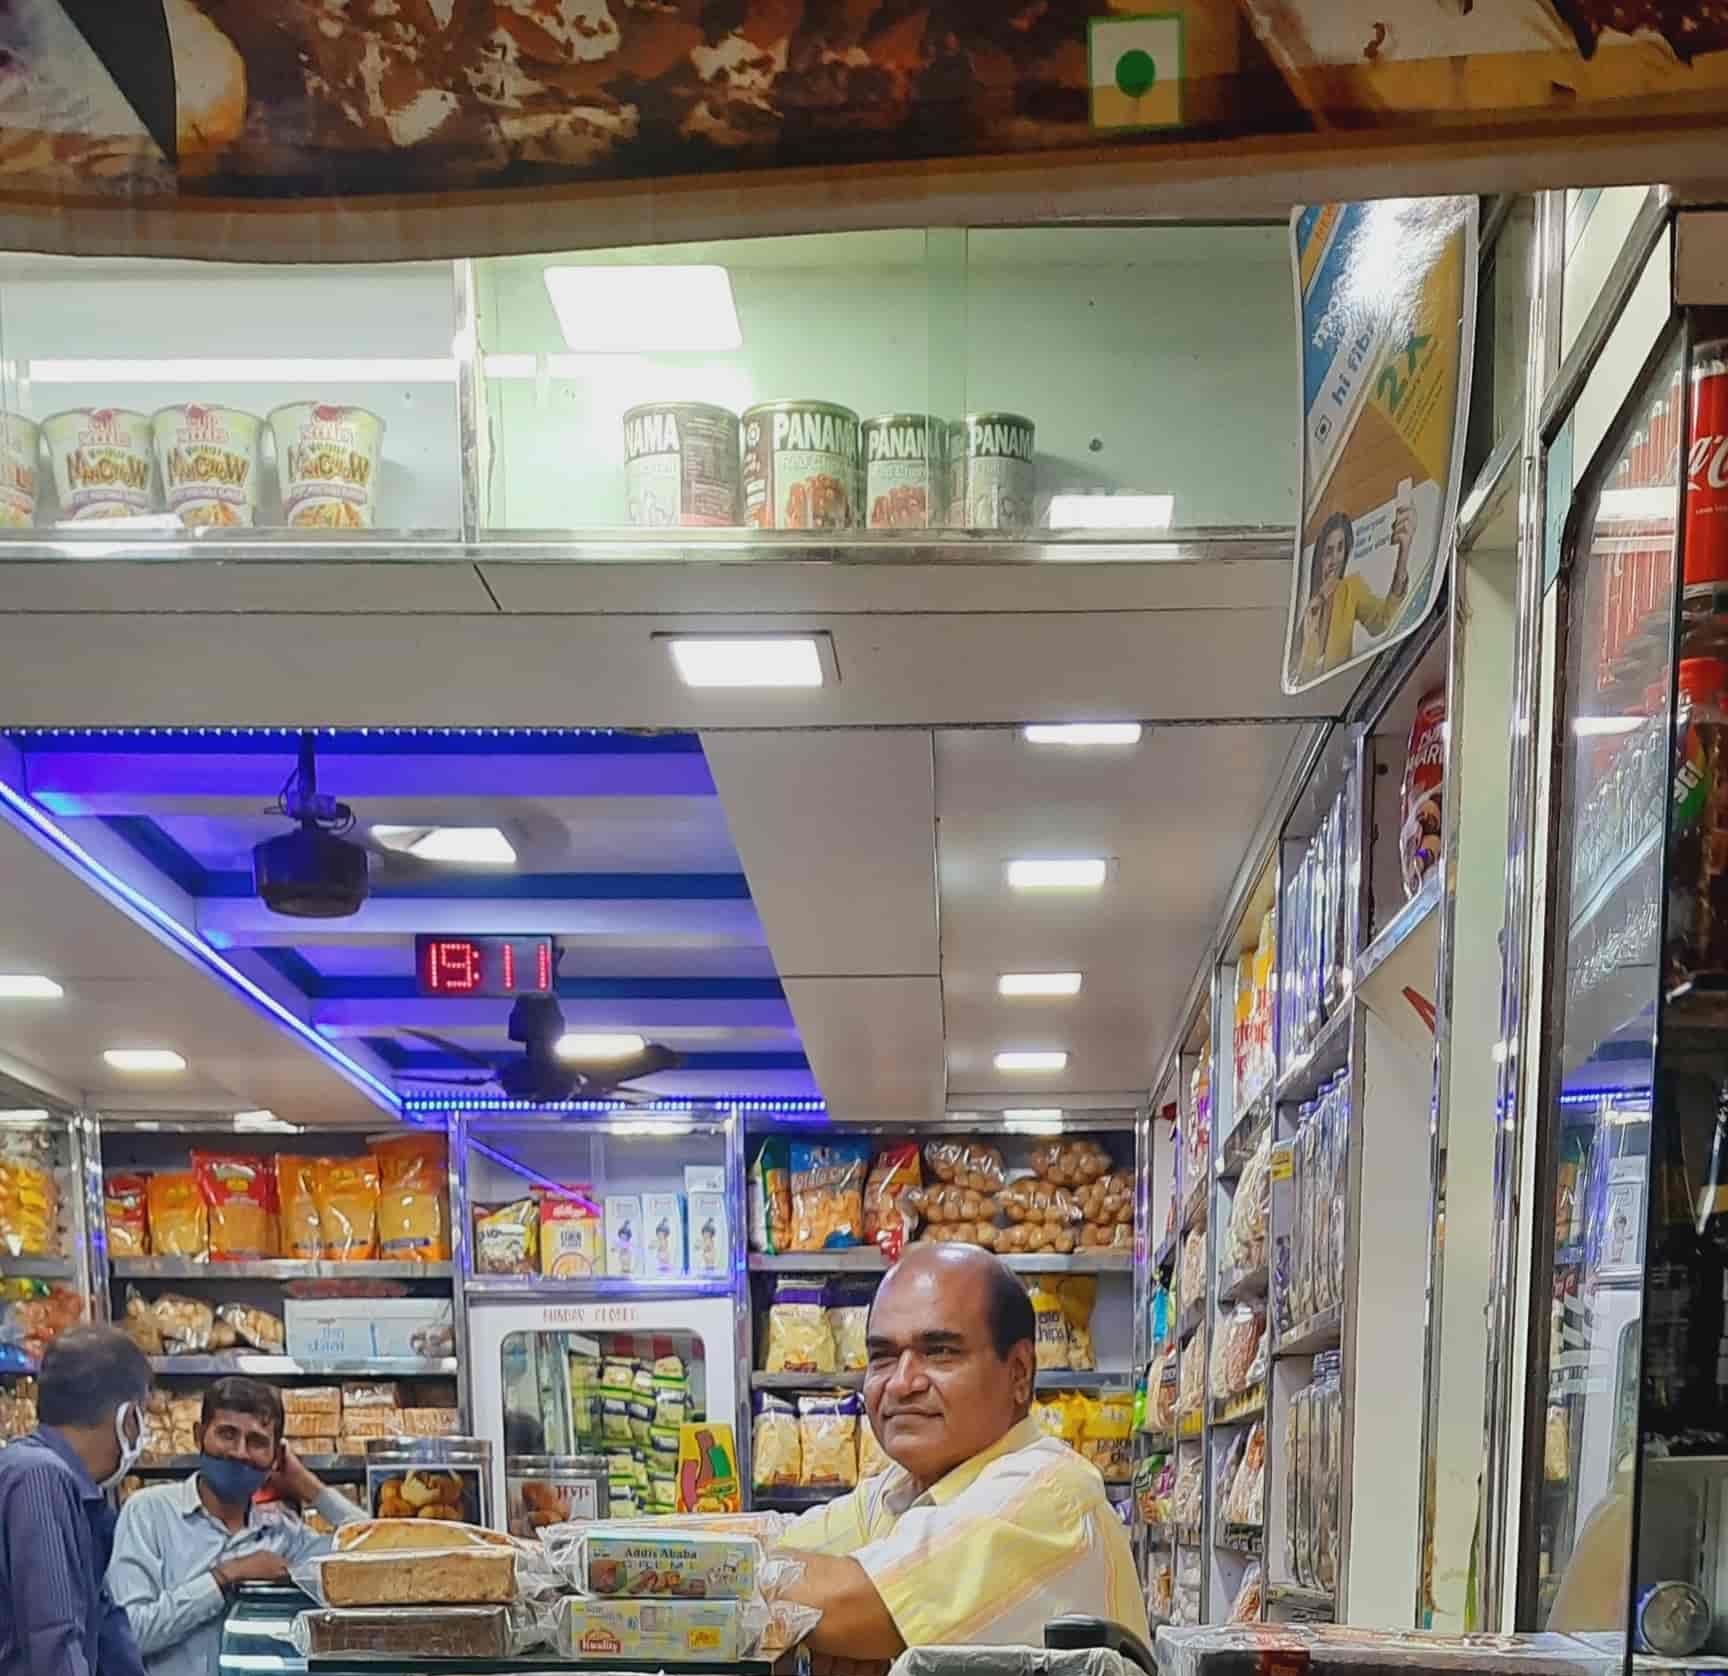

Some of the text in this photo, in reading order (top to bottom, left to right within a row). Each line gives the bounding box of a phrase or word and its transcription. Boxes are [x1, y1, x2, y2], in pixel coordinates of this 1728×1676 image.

[430, 943, 549, 988] 19:11
[625, 1548, 697, 1560] Addis Ababa
